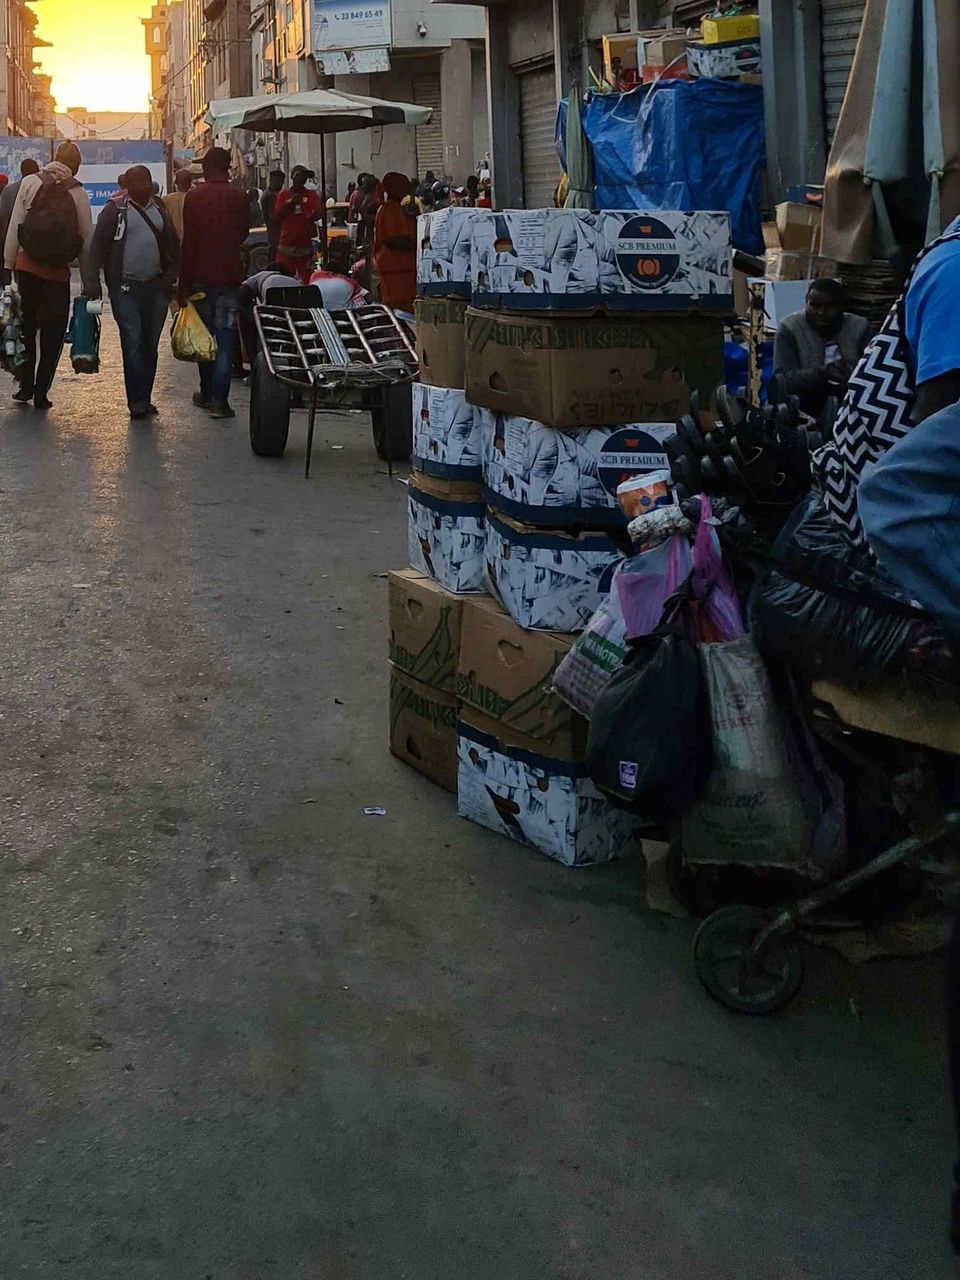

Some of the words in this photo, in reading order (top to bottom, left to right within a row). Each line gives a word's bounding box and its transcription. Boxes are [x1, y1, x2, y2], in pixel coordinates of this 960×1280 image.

[341, 12, 349, 20] 33
[350, 11, 363, 19] 849
[365, 10, 373, 18] 65
[374, 9, 383, 17] 49
[618, 242, 634, 250] SCB
[636, 242, 676, 251] PREMIUM
[600, 455, 617, 464] SCB
[620, 455, 665, 465] PREMIUM
